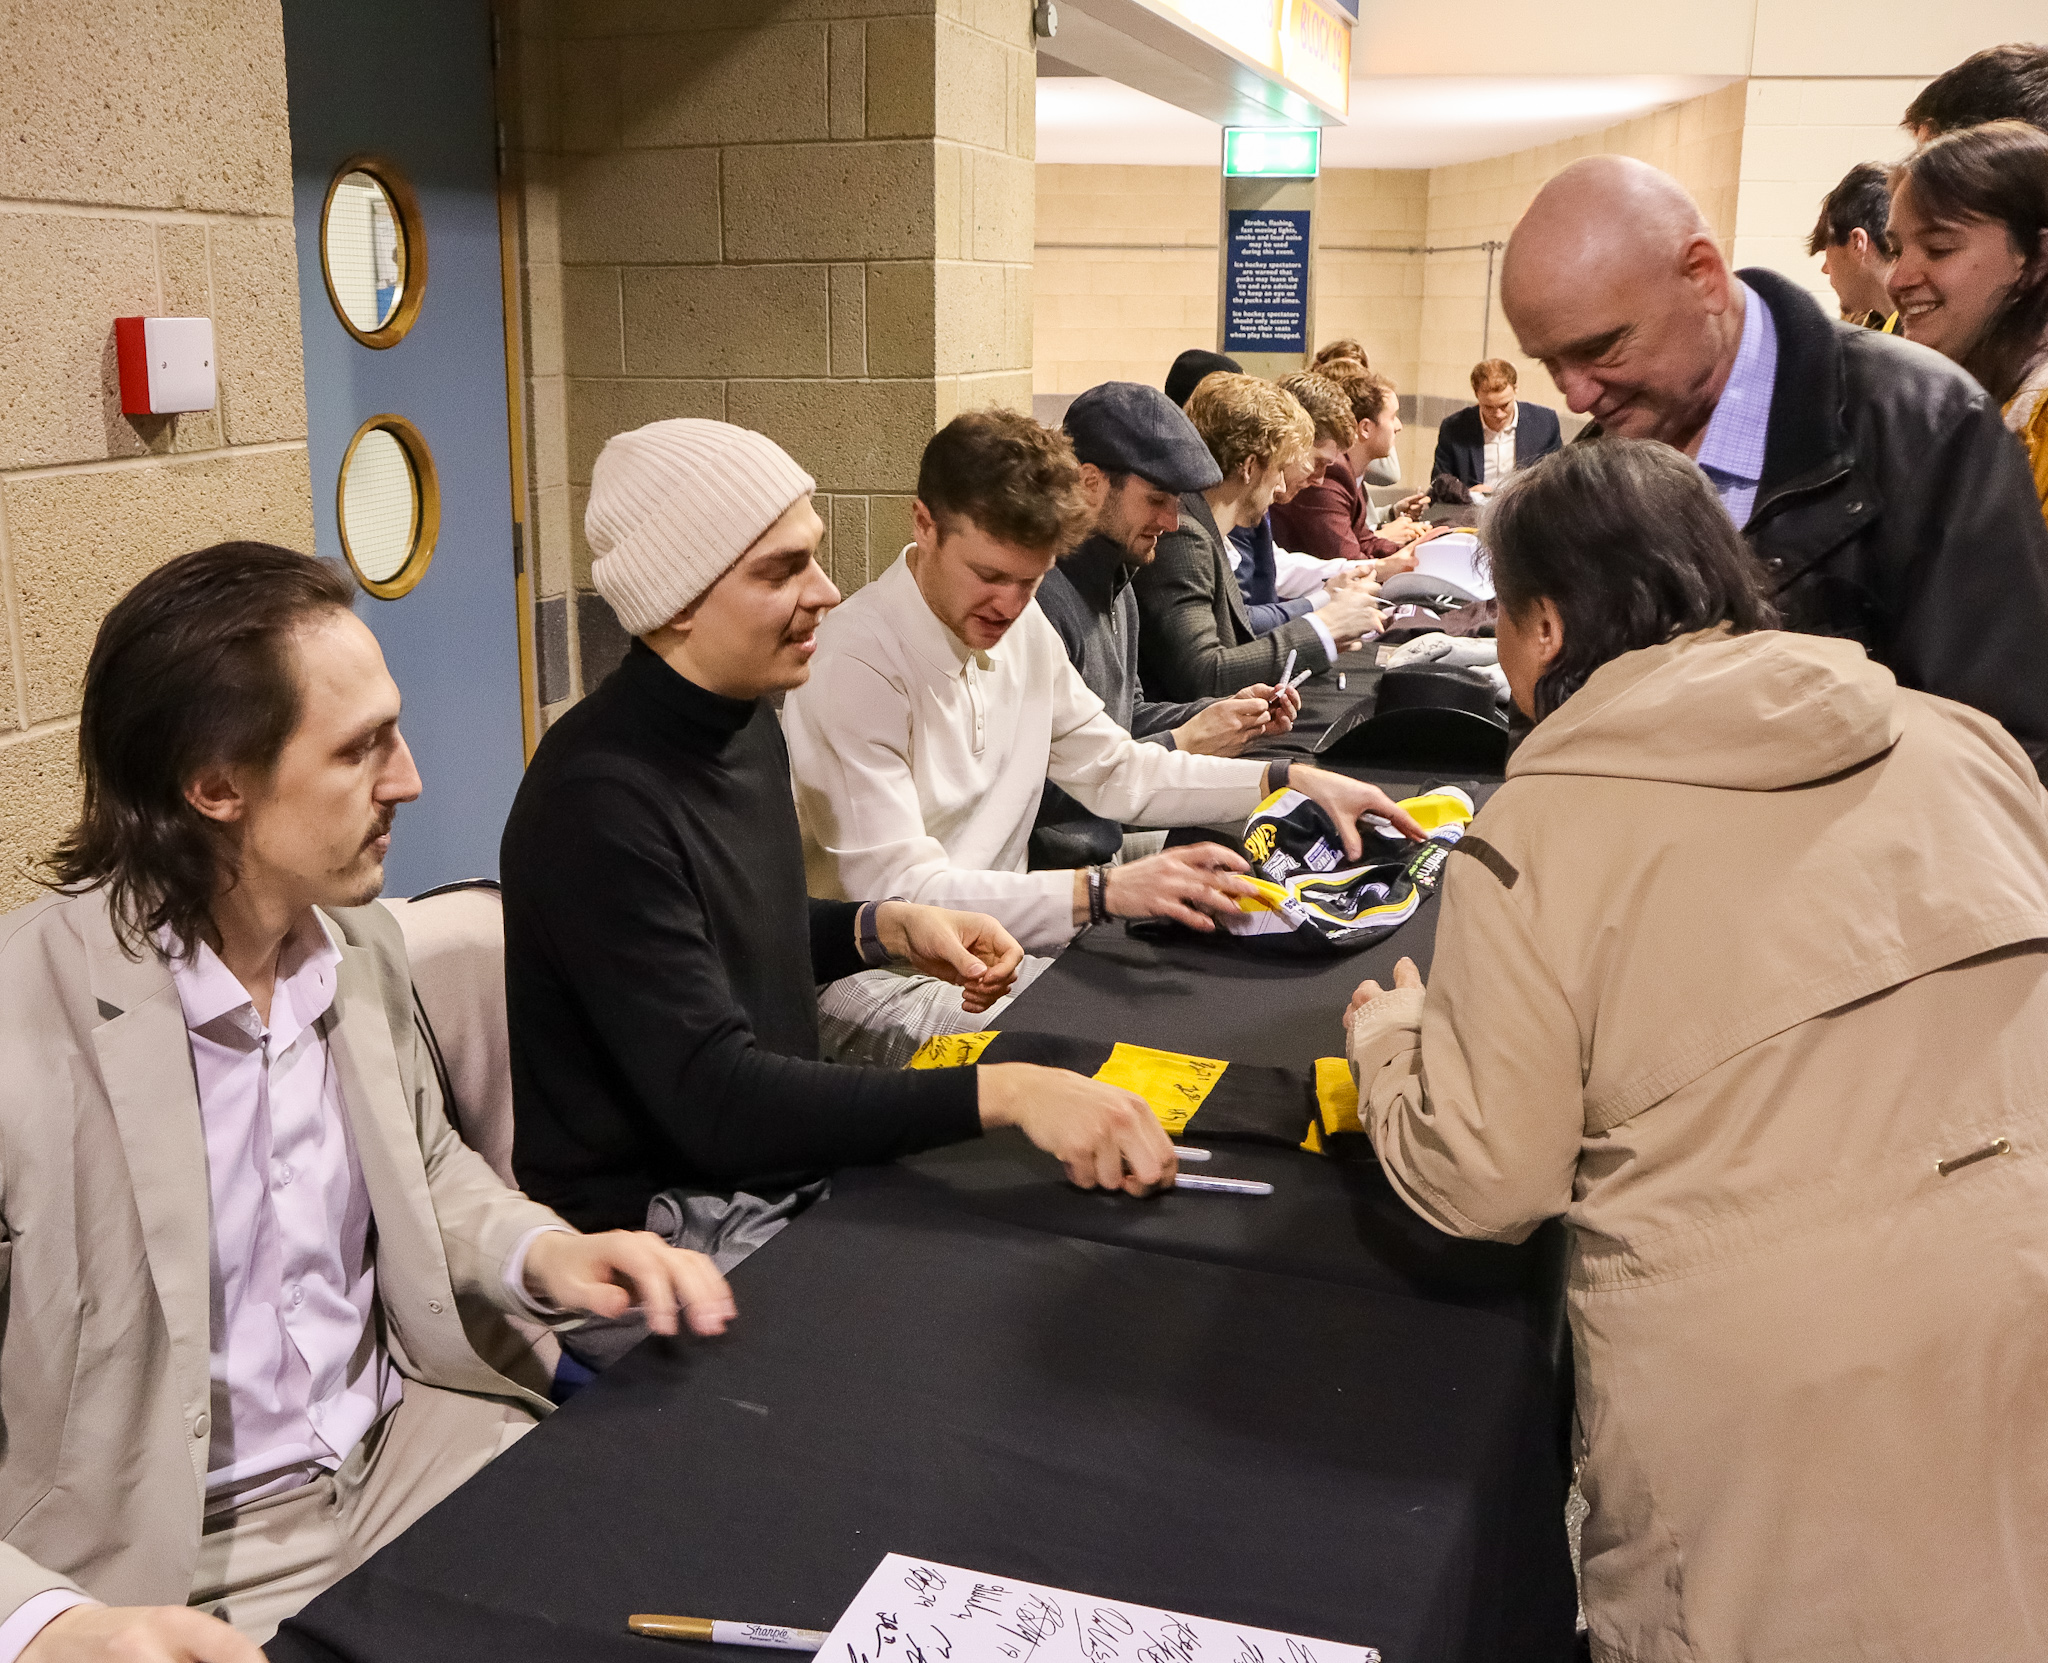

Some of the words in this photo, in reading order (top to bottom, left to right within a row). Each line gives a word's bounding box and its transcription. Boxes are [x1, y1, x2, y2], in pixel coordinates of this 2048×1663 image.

[1244, 219, 1267, 227] Strobe,
[1268, 219, 1294, 228] flashing,
[1241, 248, 1261, 256] during
[1245, 261, 1267, 269] hockey
[1244, 297, 1262, 305] pucks
[1243, 310, 1265, 318] hockey
[1274, 332, 1301, 340] stopped.
[741, 1624, 790, 1640] Sharpie
